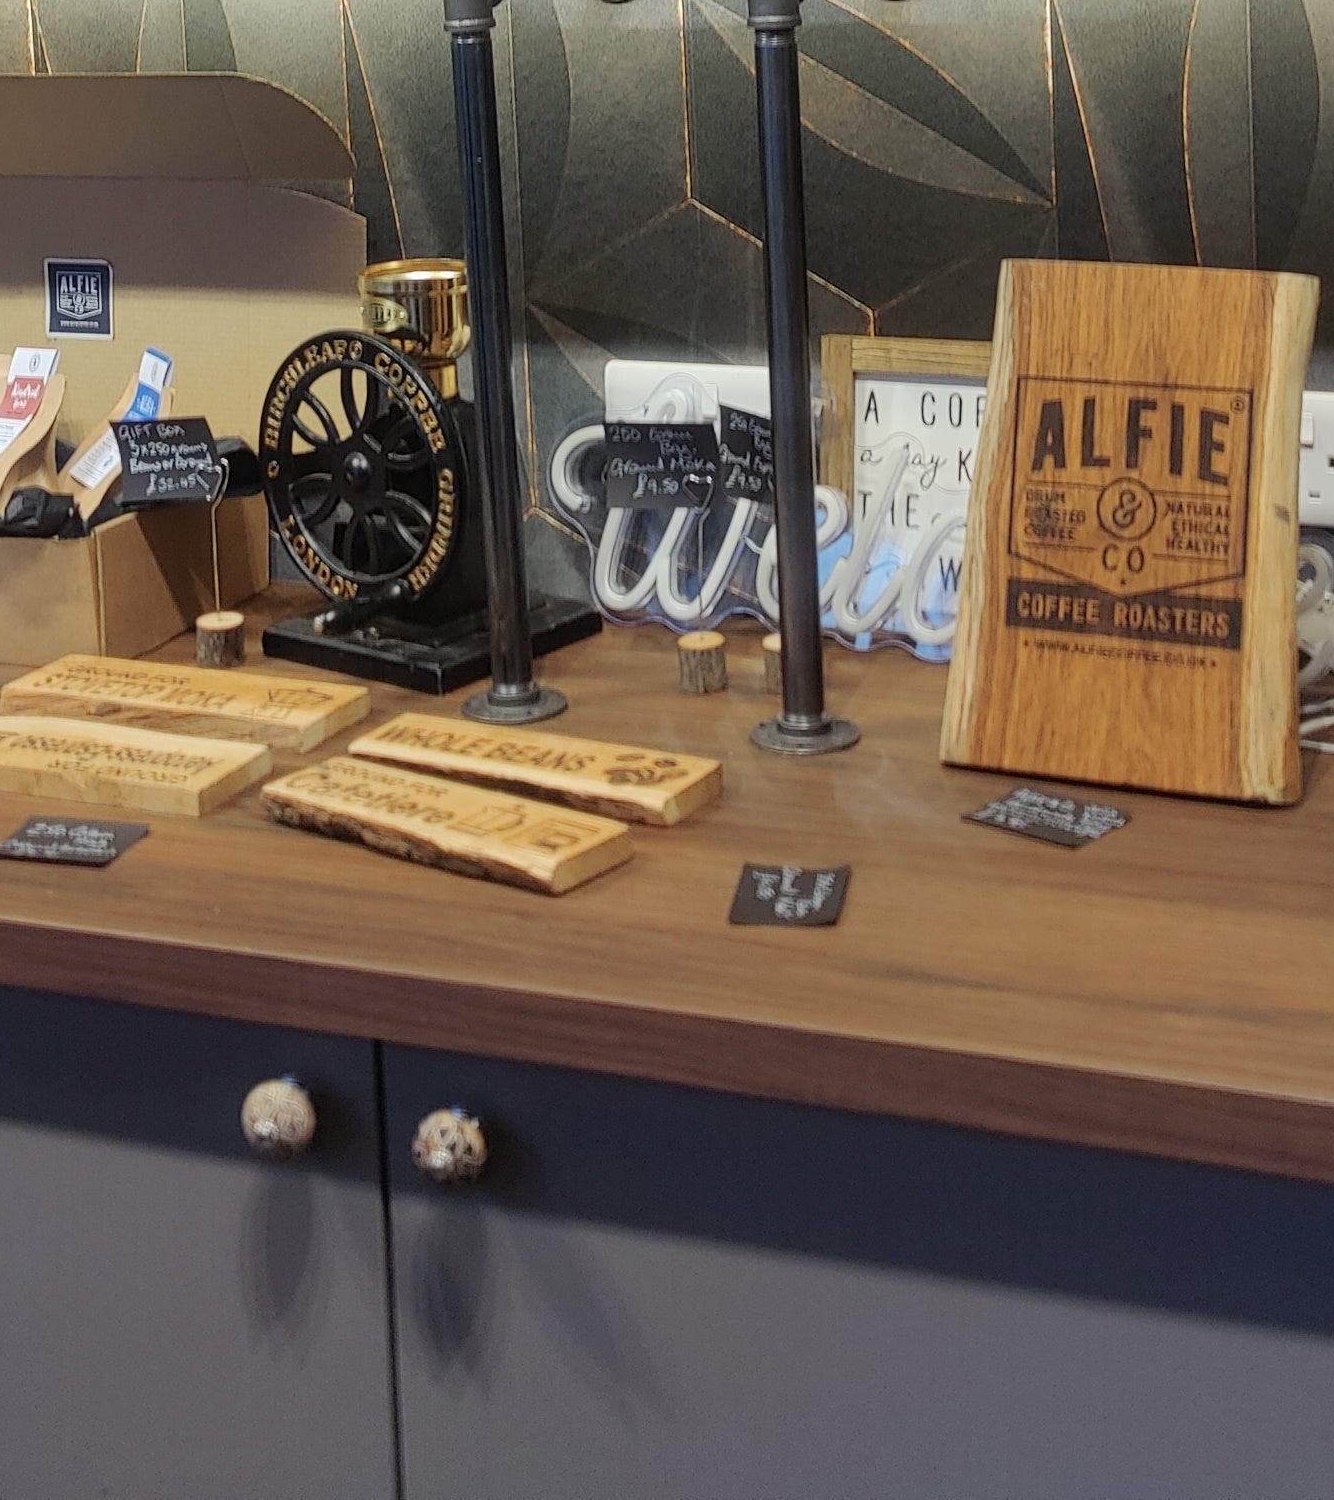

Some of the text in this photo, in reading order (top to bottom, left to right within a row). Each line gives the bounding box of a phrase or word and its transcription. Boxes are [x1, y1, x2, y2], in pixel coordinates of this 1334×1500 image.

[60, 275, 98, 293] ALFIE
[864, 390, 987, 428] A COF
[1031, 395, 1230, 486] ALFIE
[901, 442, 947, 490] ay
[1025, 507, 1087, 524] ROASTED
[1112, 489, 1143, 529] &
[1166, 502, 1230, 518] NATURAL
[1024, 524, 1076, 540] COFFEE
[1172, 519, 1230, 535] ETHICAL
[1102, 543, 1145, 573] CO
[1167, 537, 1229, 555] HEALTHY
[1017, 592, 1230, 639] COFFEE ROASTERS
[377, 723, 596, 772] WHOLE BEANS
